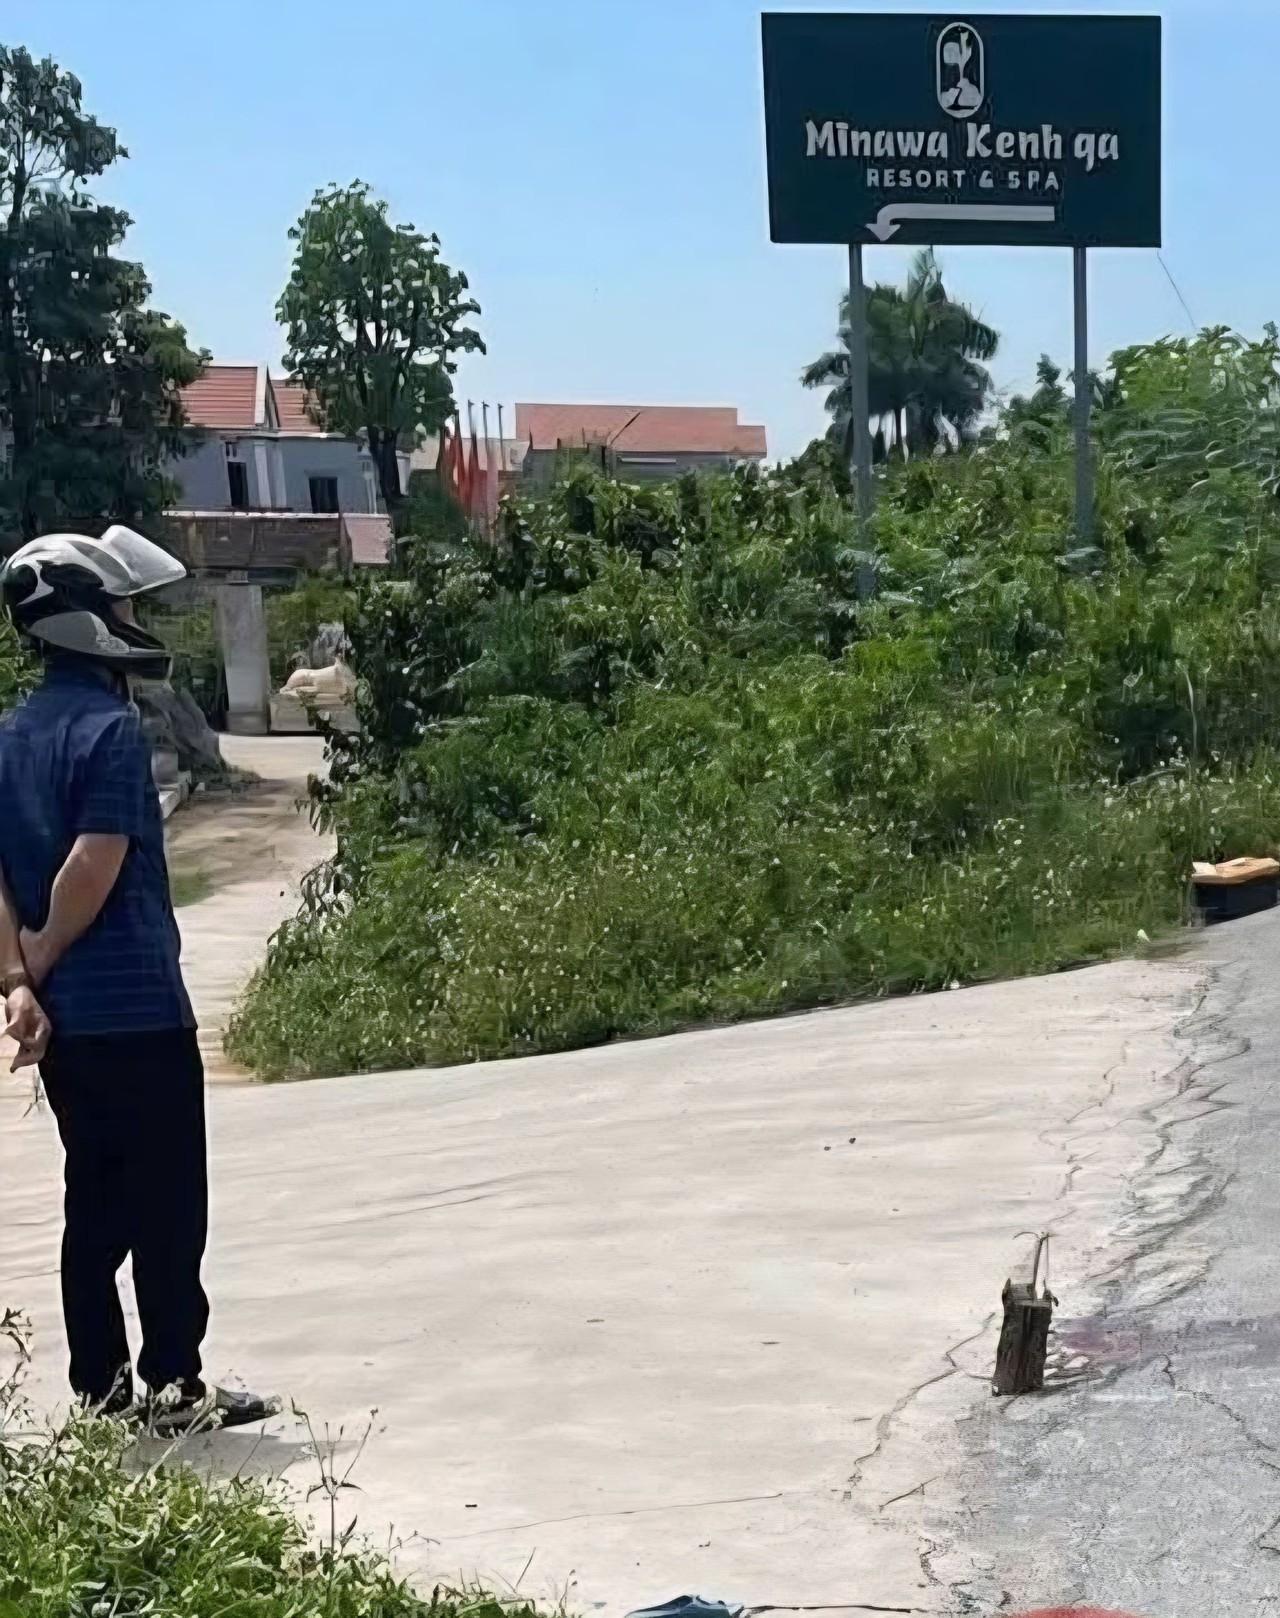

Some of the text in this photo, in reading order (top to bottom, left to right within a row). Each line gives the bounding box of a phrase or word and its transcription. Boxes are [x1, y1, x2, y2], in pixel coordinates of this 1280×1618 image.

[805, 121, 948, 158] Minawa
[966, 122, 1063, 160] Kenh
[866, 168, 965, 188] RESORT
[1008, 170, 1060, 190] SPA
